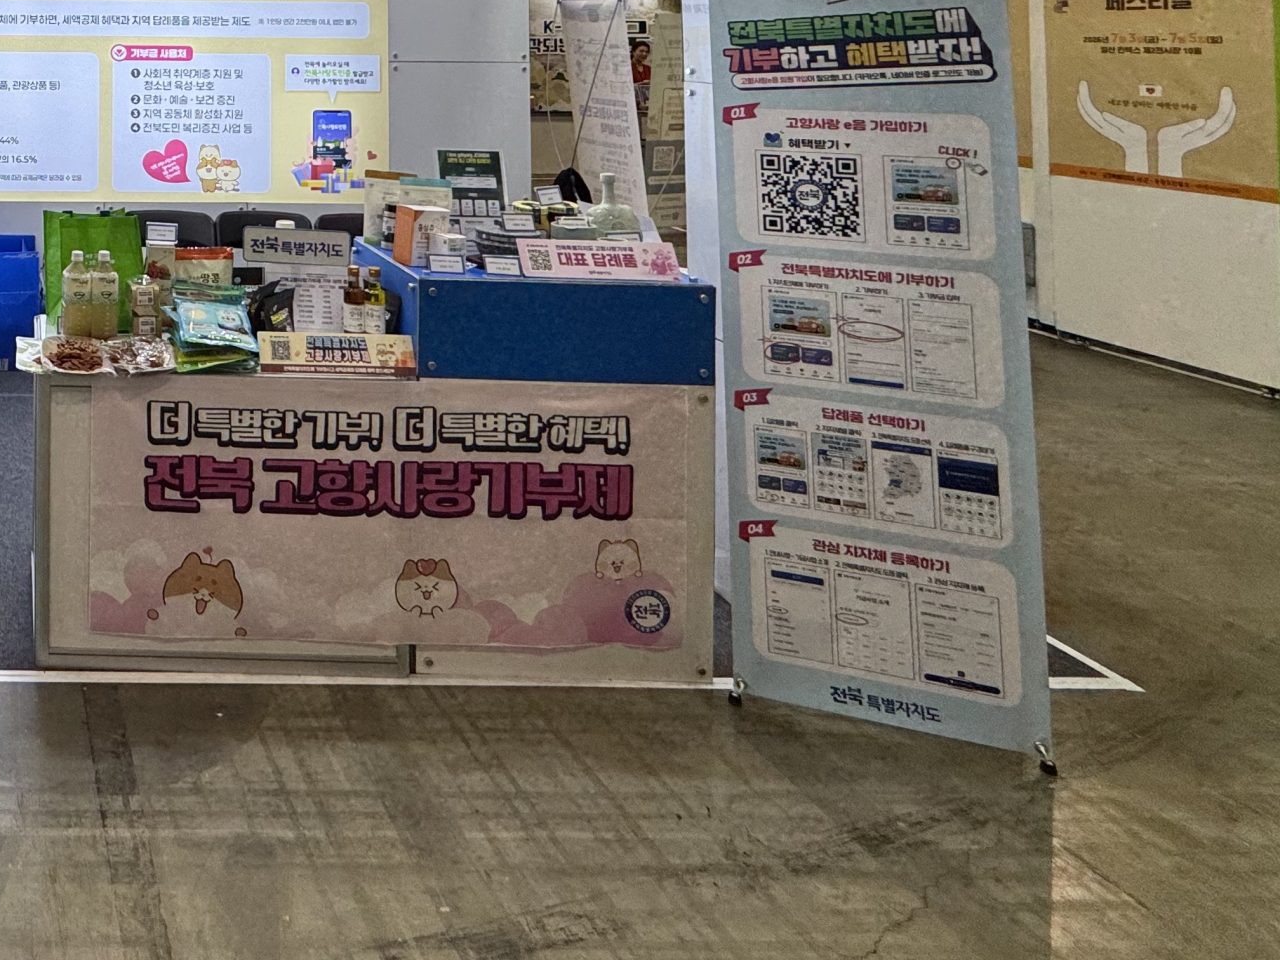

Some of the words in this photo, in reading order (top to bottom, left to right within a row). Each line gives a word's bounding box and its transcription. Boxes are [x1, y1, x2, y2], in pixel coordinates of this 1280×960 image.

[132, 15, 151, 26] 지역
[232, 16, 250, 26] 제도
[727, 6, 970, 46] 전북특별자치도에
[723, 44, 839, 72] 기부하고
[845, 36, 982, 66] 혜택받자!
[143, 69, 171, 78] 사회적
[174, 69, 210, 79] 취약계층
[214, 69, 232, 79] 지원
[144, 81, 171, 90] 청소년
[143, 95, 161, 104] 문화
[196, 96, 214, 105] 보건
[143, 109, 161, 118] 지역
[164, 109, 192, 118] 공동체
[225, 110, 243, 119] 지원
[730, 106, 746, 118] 01
[143, 123, 180, 133] 전북도민
[222, 124, 241, 133] 사업
[785, 117, 840, 130] 고향사랑
[870, 120, 928, 133] 가입하기
[788, 138, 839, 150] 혜택받기
[938, 145, 970, 158] CLICK
[11, 156, 37, 164] 16.5%
[557, 252, 589, 266] 대표
[592, 254, 638, 268] 답례품
[737, 254, 752, 265] 02
[781, 262, 893, 284] 전북특별자치도에
[896, 273, 955, 289] 기부하기
[742, 392, 758, 403] 03
[821, 407, 863, 423] 답례품
[868, 413, 926, 432] 선택하기
[146, 400, 192, 445] 더
[195, 406, 301, 448] 특별한
[302, 410, 381, 450] 기부!
[393, 405, 438, 449] 더
[439, 410, 547, 450] 특별한
[545, 412, 630, 455] 혜택!
[144, 454, 253, 513] 전북
[259, 455, 635, 521] 고향사랑기부제
[747, 524, 763, 535] 04
[812, 538, 840, 555] 관심
[845, 545, 887, 563] 지자체
[890, 552, 950, 574] 등록하기
[634, 603, 661, 619] 전북
